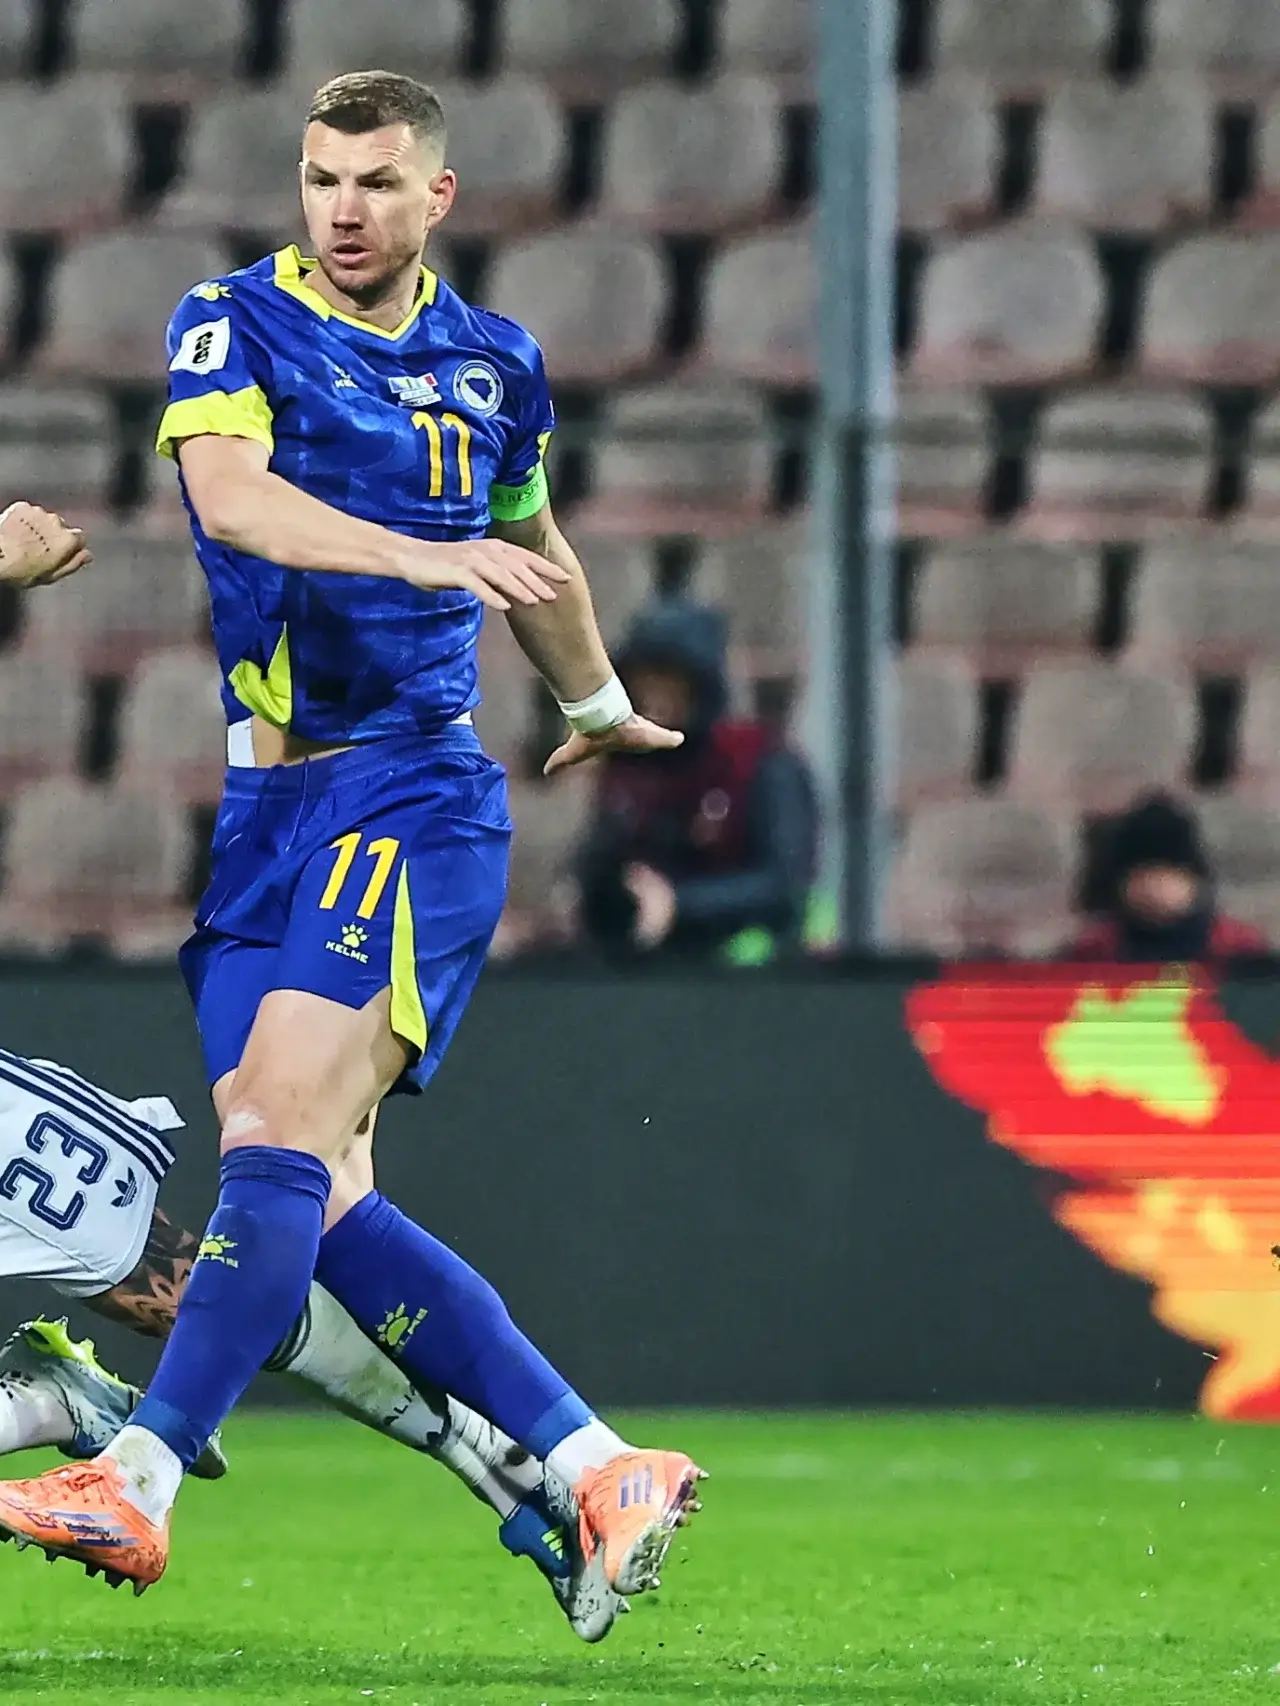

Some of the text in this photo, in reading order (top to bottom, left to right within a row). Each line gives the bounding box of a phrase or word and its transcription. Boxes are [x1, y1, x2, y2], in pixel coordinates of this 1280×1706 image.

[411, 411, 472, 497] 11
[319, 832, 400, 920] 11
[325, 941, 369, 964] KELME
